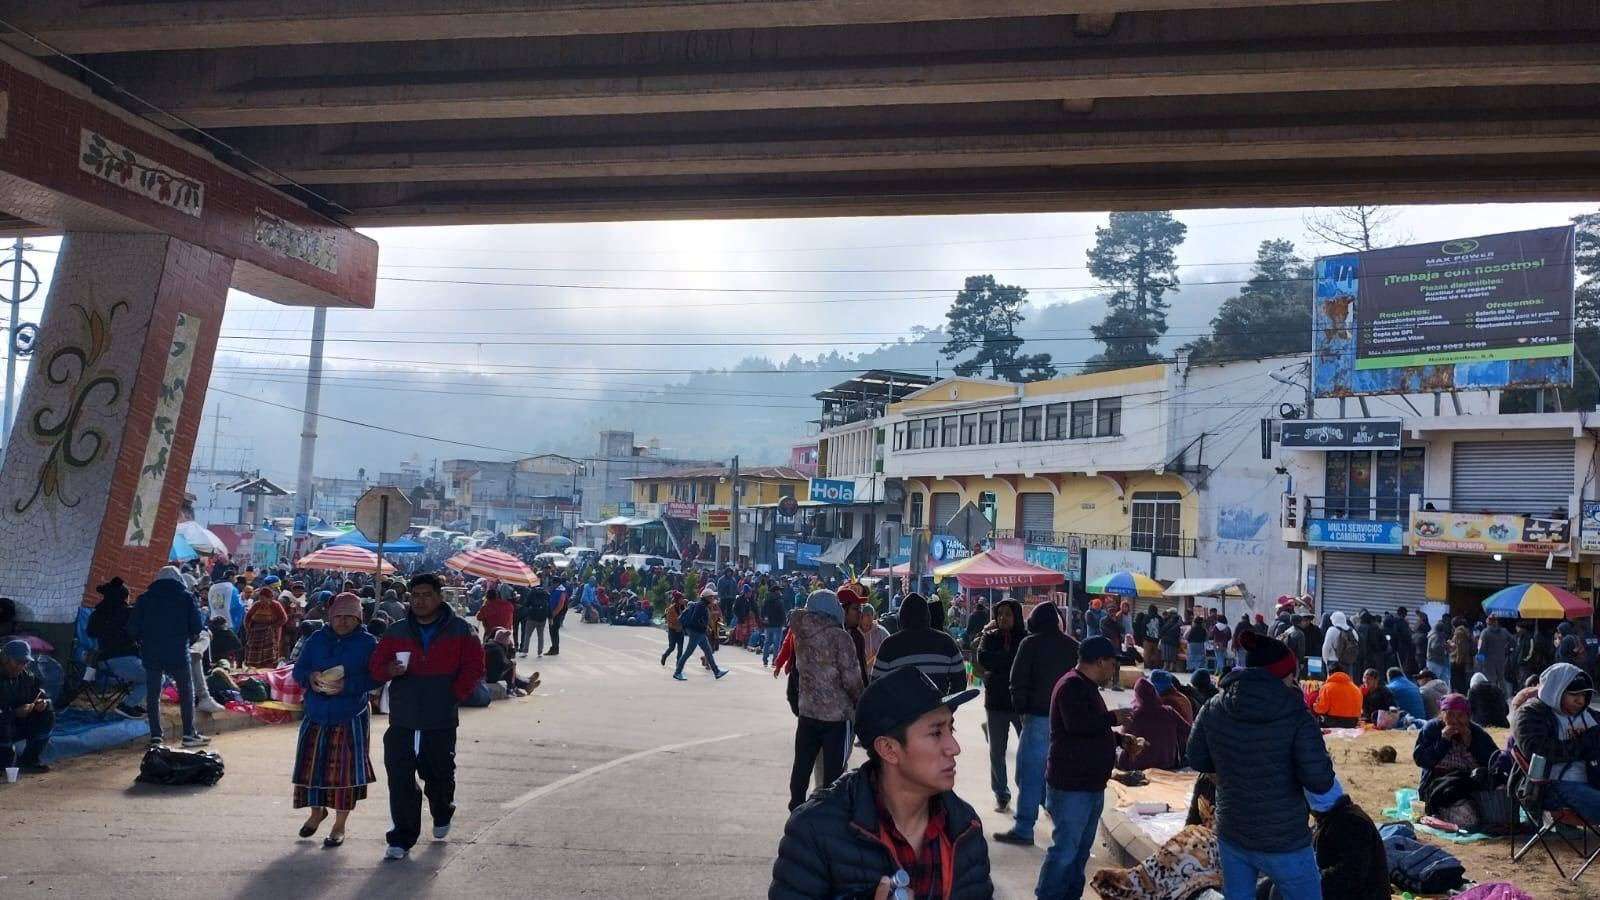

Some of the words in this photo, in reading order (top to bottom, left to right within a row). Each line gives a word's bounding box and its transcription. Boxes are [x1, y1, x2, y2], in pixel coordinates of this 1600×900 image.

[1425, 256, 1450, 265] MAX
[1454, 251, 1495, 262] POWER
[1385, 270, 1440, 286] ¡Trabaja
[1444, 268, 1472, 278] con
[1475, 258, 1545, 274] nosotros!
[1486, 298, 1544, 309] Ofrecemos:
[1379, 308, 1430, 319] Requisitos:
[1529, 335, 1558, 344] Xela
[812, 482, 853, 501] Hola
[1328, 523, 1347, 533] MULTI
[1348, 523, 1383, 533] SERVICIOS
[1329, 533, 1335, 541] 4
[1335, 532, 1366, 542] CAMINOS
[985, 575, 1033, 586] DIRECT
